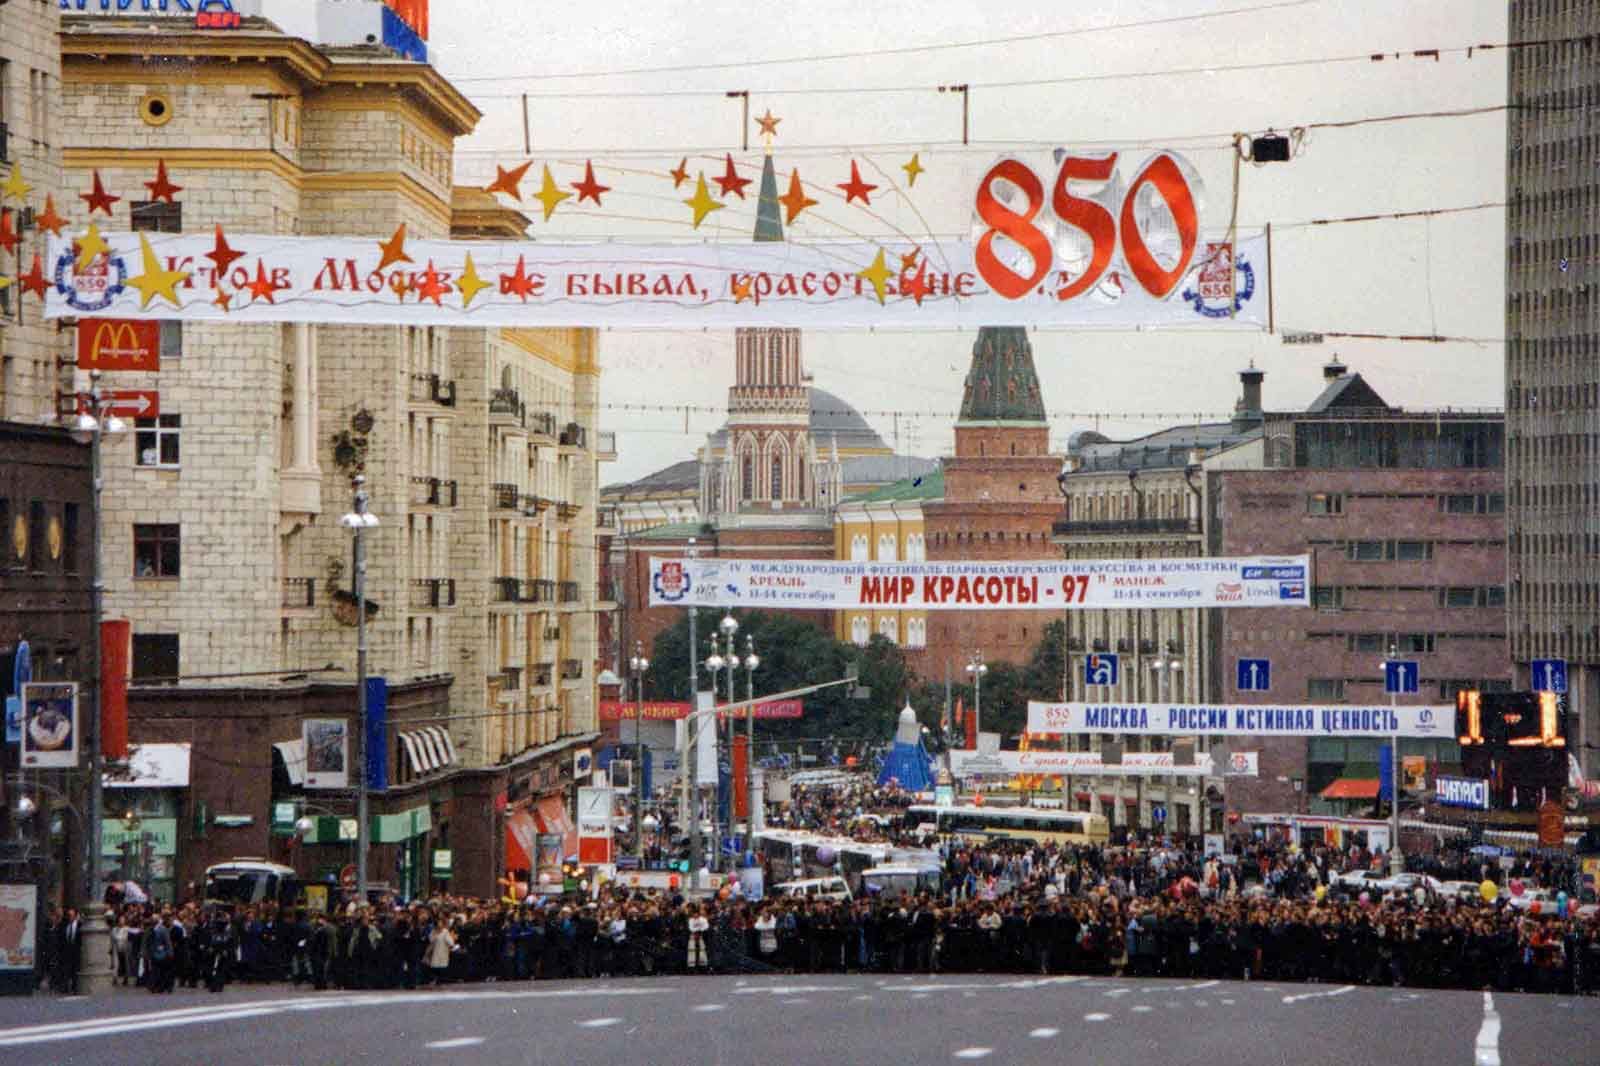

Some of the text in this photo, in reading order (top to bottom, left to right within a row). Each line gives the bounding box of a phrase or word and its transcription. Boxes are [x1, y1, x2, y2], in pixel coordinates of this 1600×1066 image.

[975, 152, 1198, 301] 850
[750, 575, 806, 587] КРЕМЛЬ
[923, 575, 1038, 604] КРАСОТЫ
[1045, 707, 1070, 720] 850
[1085, 707, 1149, 730] МОСКВА
[1168, 708, 1228, 730] РОССИИ
[1235, 708, 1314, 731] ИСТИННАЯ
[1321, 709, 1398, 733] ЦЕННОСТЬ
